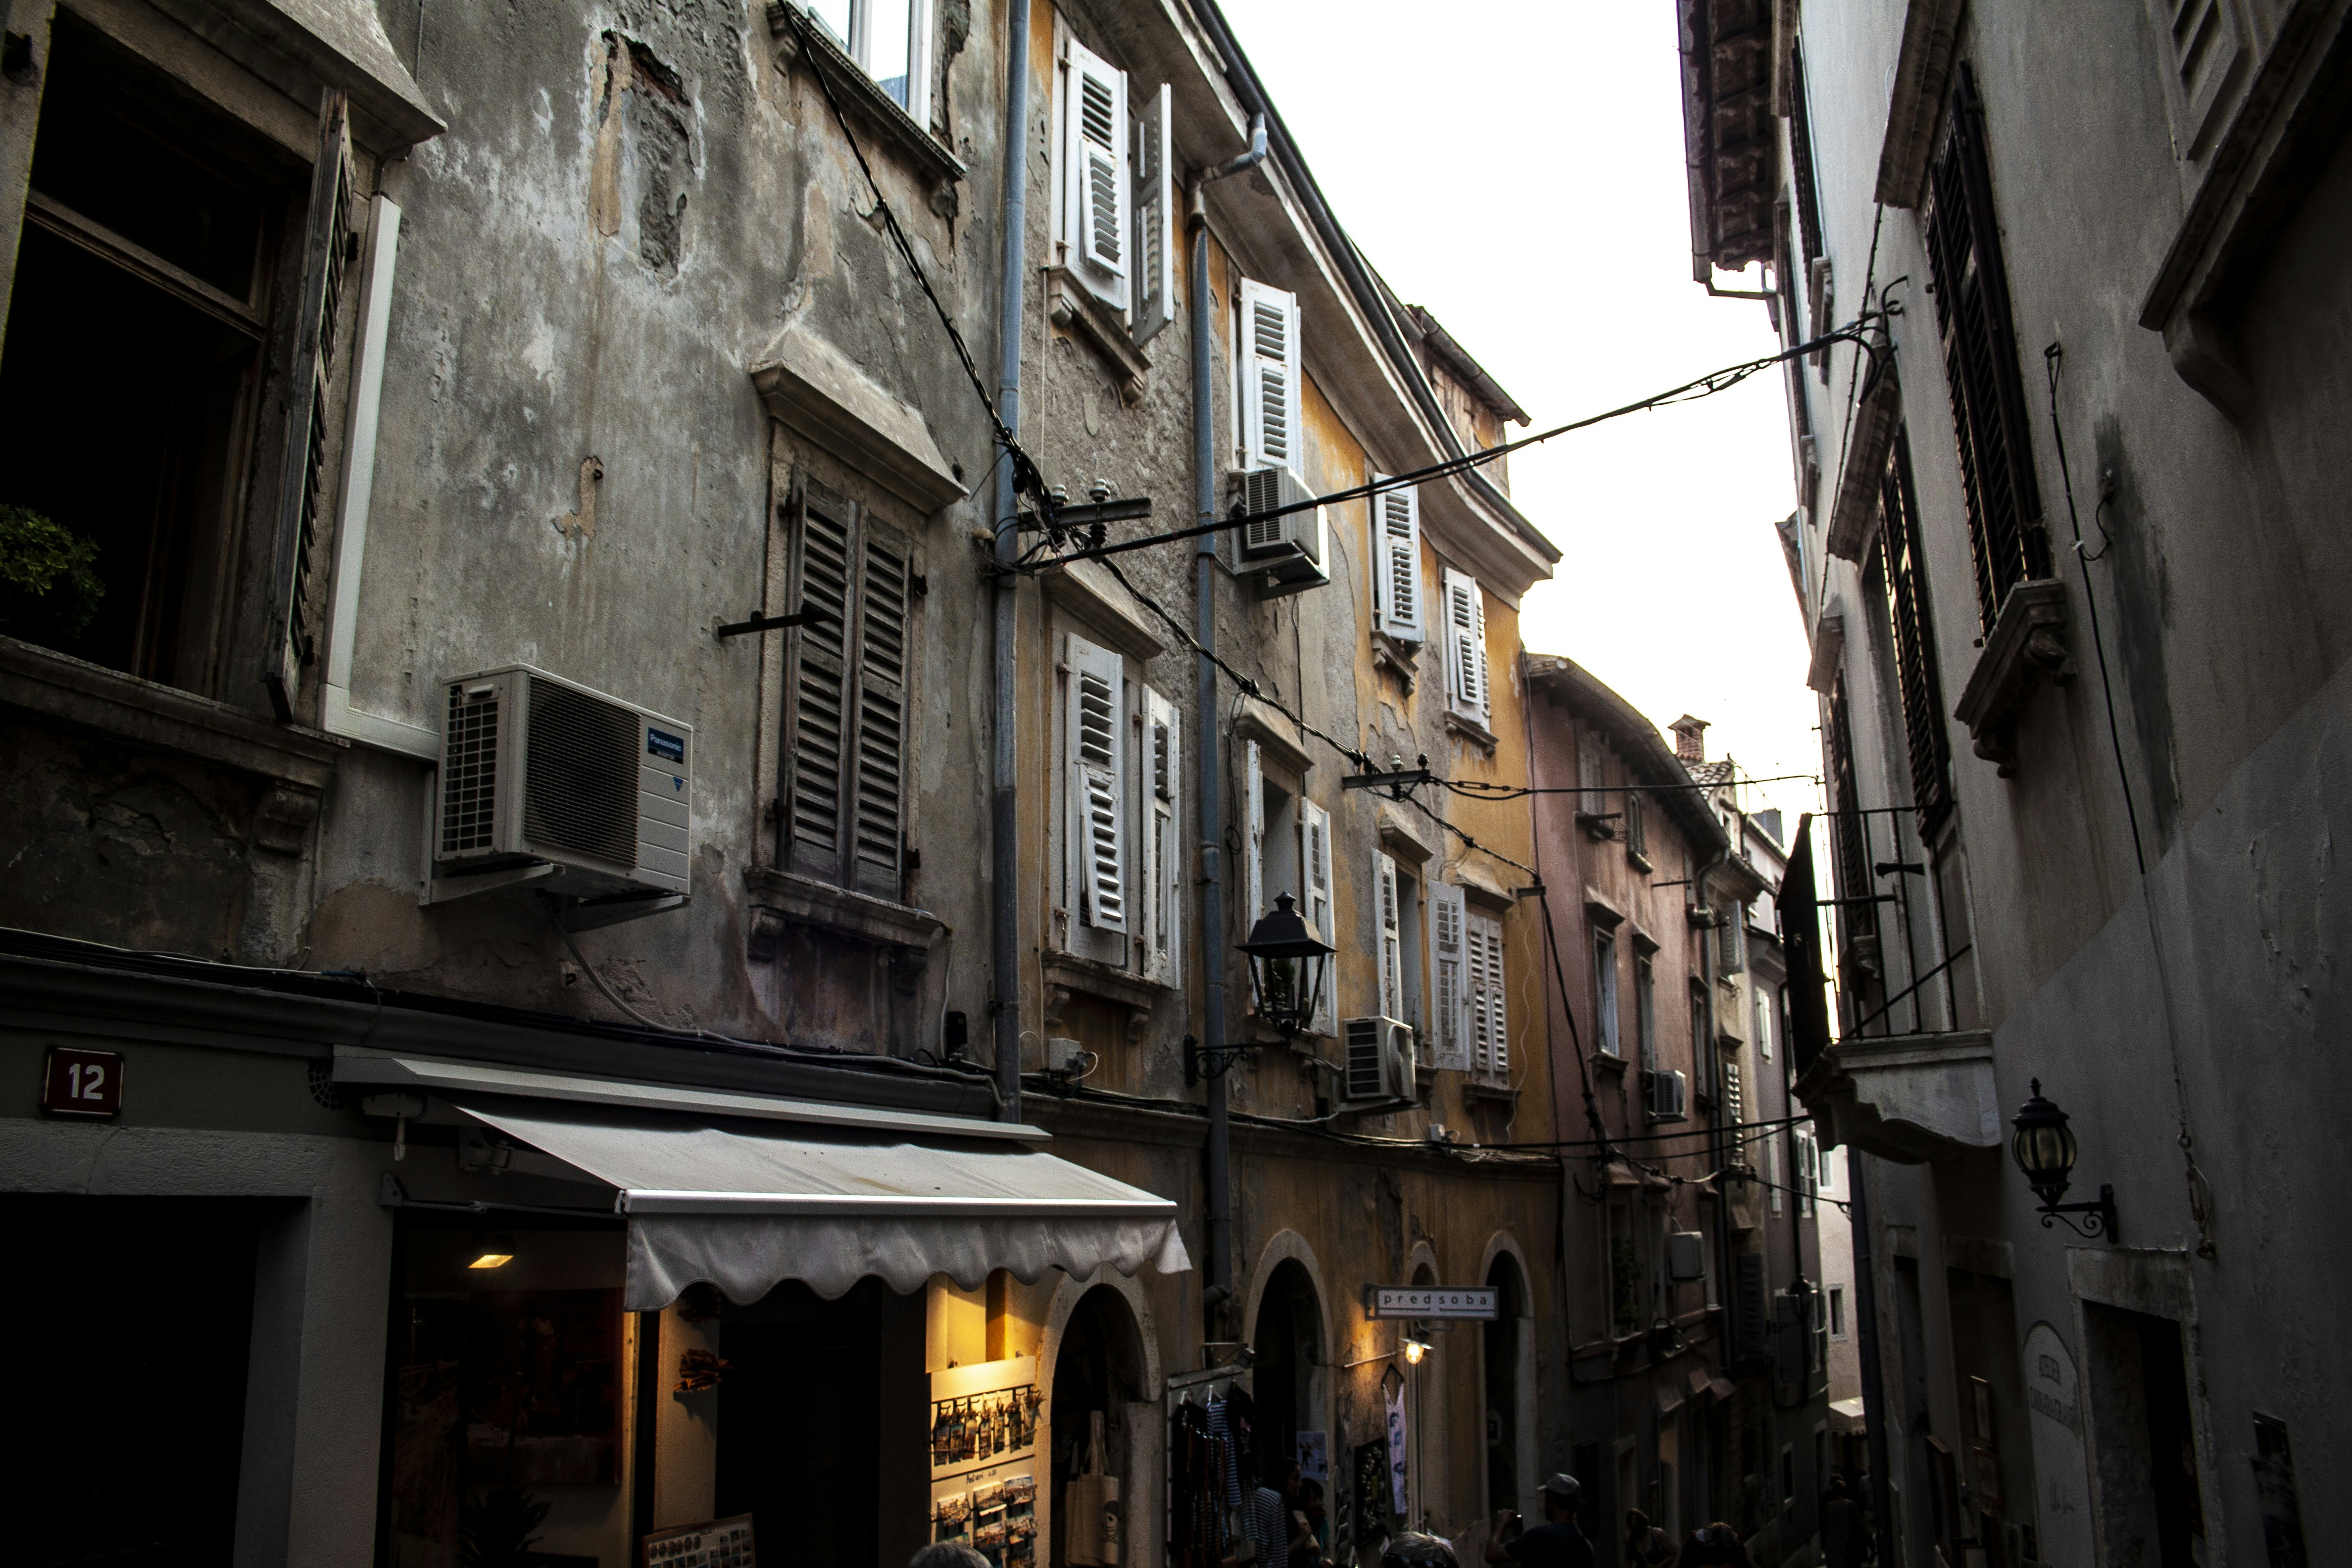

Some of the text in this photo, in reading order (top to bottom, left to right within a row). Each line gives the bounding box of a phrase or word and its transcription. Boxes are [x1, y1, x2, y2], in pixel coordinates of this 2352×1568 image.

[650, 734, 682, 751] Panasonic
[68, 1063, 104, 1100] 12
[1384, 1294, 1487, 1306] predsoba
